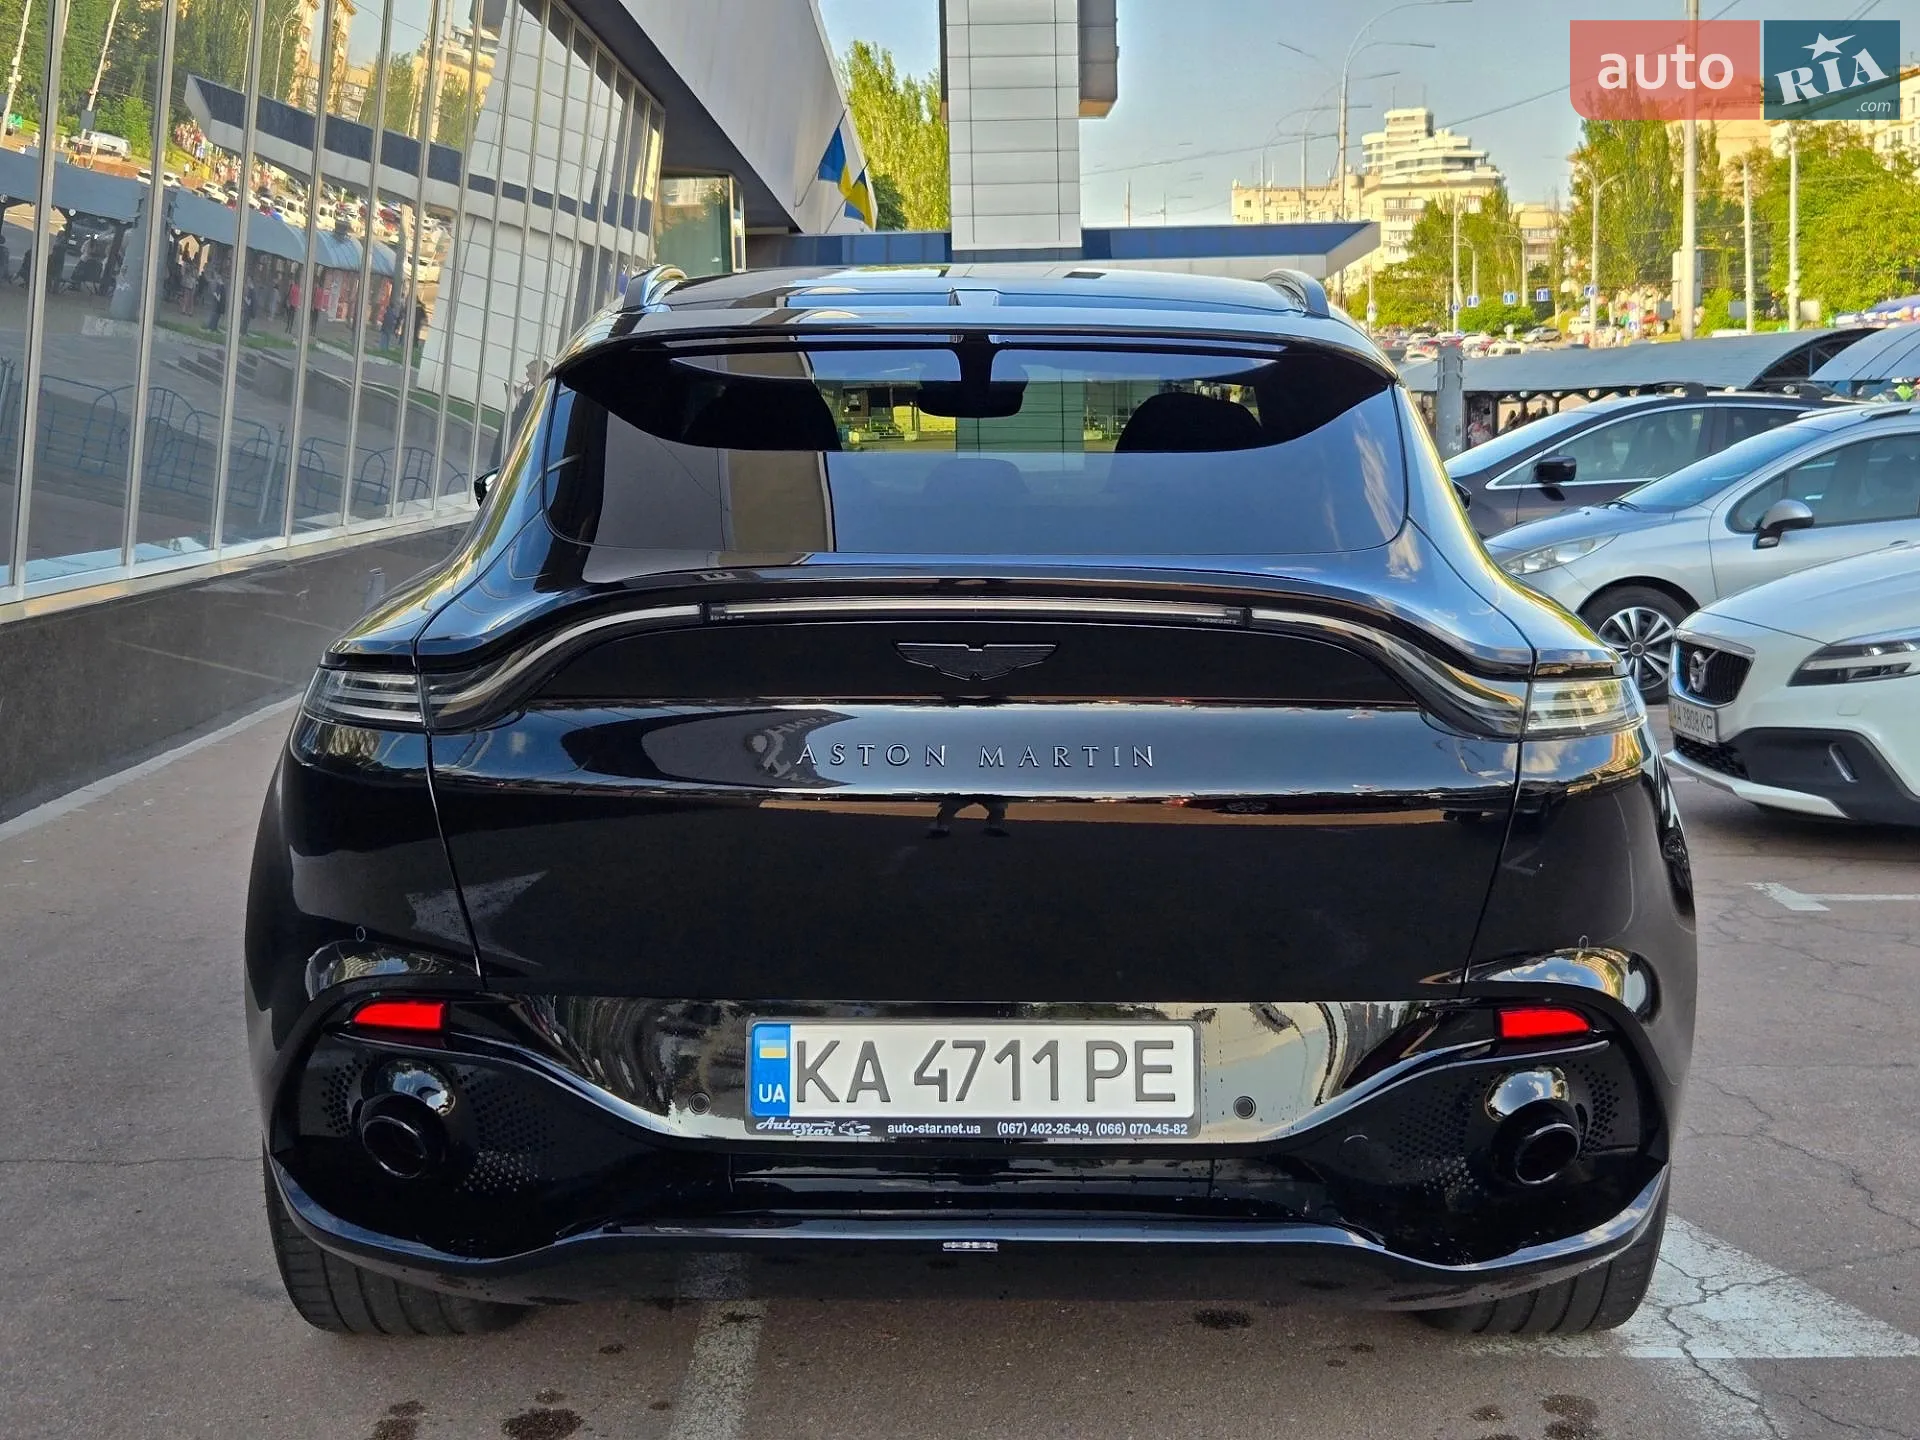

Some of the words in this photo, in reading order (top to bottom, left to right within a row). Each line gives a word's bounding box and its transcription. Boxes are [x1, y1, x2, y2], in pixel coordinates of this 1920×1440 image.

[796, 743, 946, 767] ASTON
[979, 745, 1154, 768] MARTIN
[796, 1040, 891, 1103] KA
[913, 1039, 1059, 1102] 4711
[1085, 1039, 1176, 1102] PE
[758, 1083, 786, 1103] UA
[755, 1117, 802, 1131] Auto
[792, 1121, 835, 1136] Star
[887, 1123, 981, 1135] auto-star.net.ua
[996, 1122, 1027, 1135] (067)
[1030, 1123, 1092, 1136] 402-26-49,
[1096, 1122, 1126, 1136] (066)
[1129, 1123, 1188, 1135] 070-45-82
